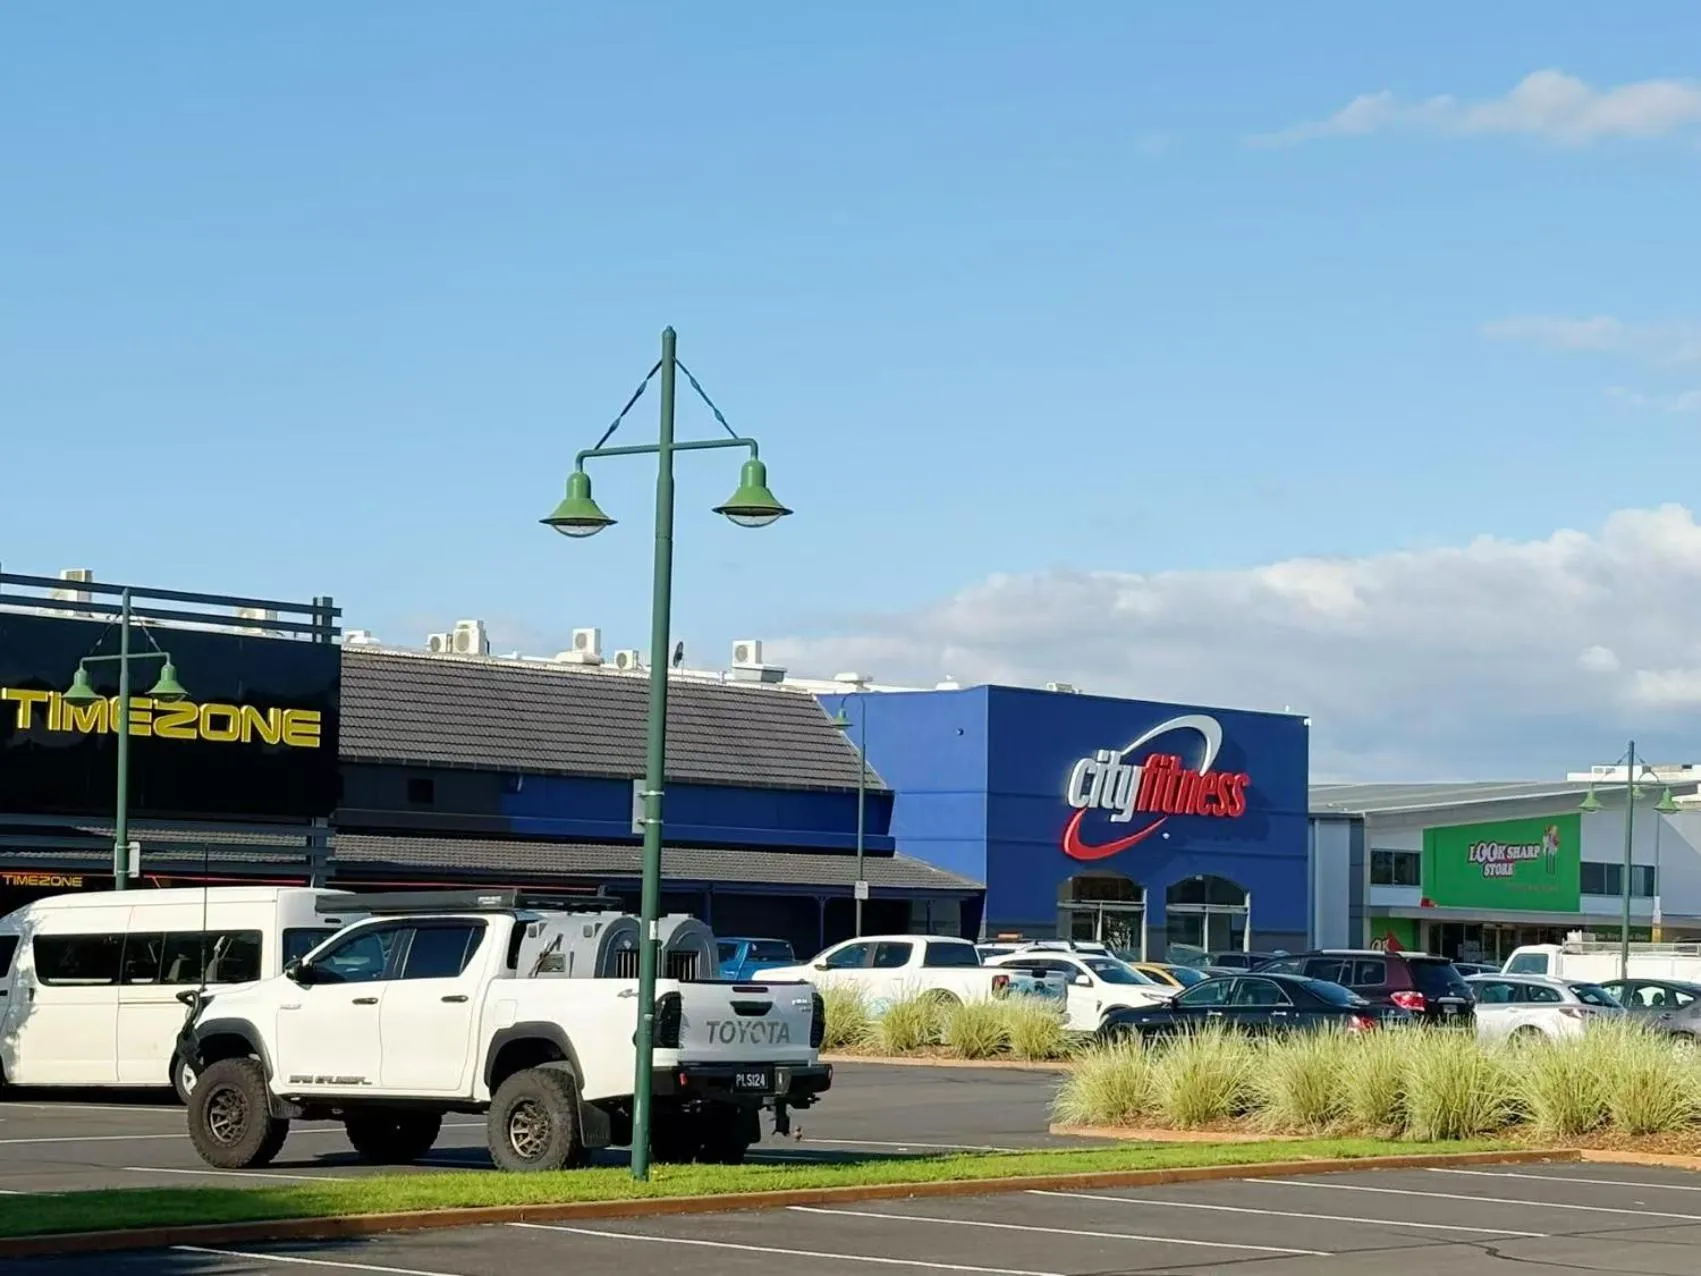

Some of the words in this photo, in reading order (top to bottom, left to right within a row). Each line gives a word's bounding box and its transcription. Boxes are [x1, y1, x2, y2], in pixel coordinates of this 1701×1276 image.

[2, 687, 321, 748] TIMEZONE
[1468, 842, 1505, 863] LOOK
[1506, 845, 1541, 859] SHARP
[1483, 862, 1515, 877] STORE
[2, 874, 83, 888] TIMEZONE
[706, 1020, 791, 1045] TOYOTA
